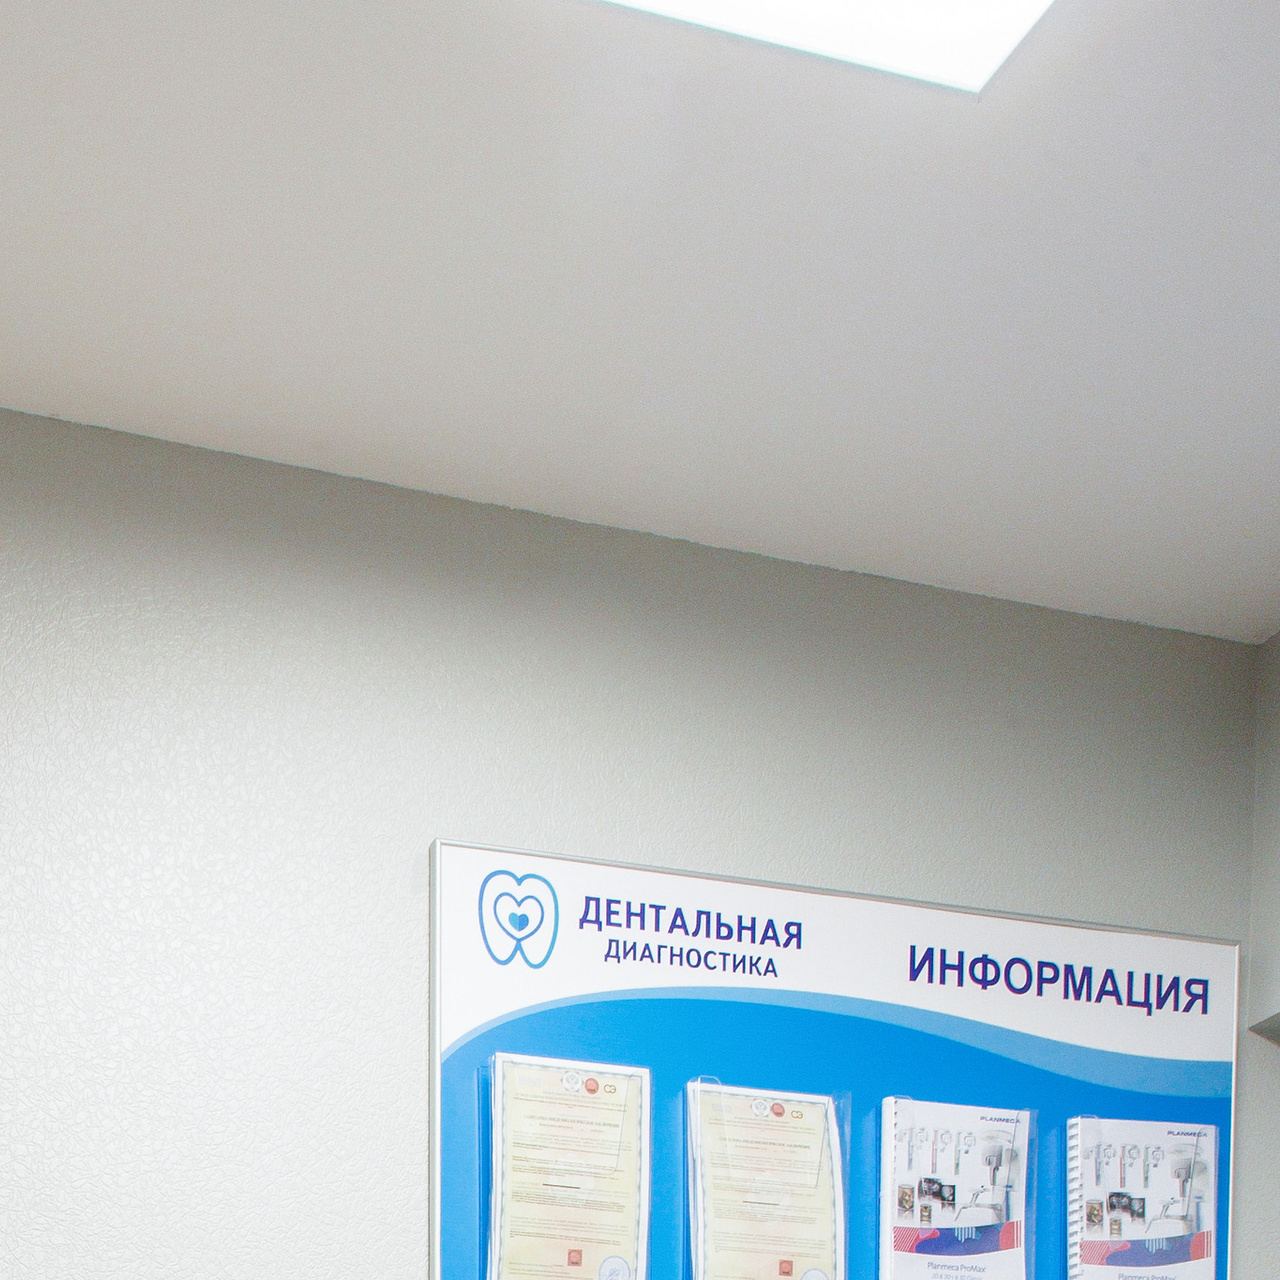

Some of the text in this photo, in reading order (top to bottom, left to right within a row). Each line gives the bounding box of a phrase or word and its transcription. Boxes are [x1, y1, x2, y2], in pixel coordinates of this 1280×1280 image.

[579, 896, 802, 949] ДЕНТАЛЬНАЯ
[605, 939, 778, 977] ДИАГНОСТИКА
[909, 945, 1209, 1016] ИНФОРМАЦИЯ
[980, 1116, 1021, 1124] PLANMECA
[927, 1262, 959, 1271] Planmeca
